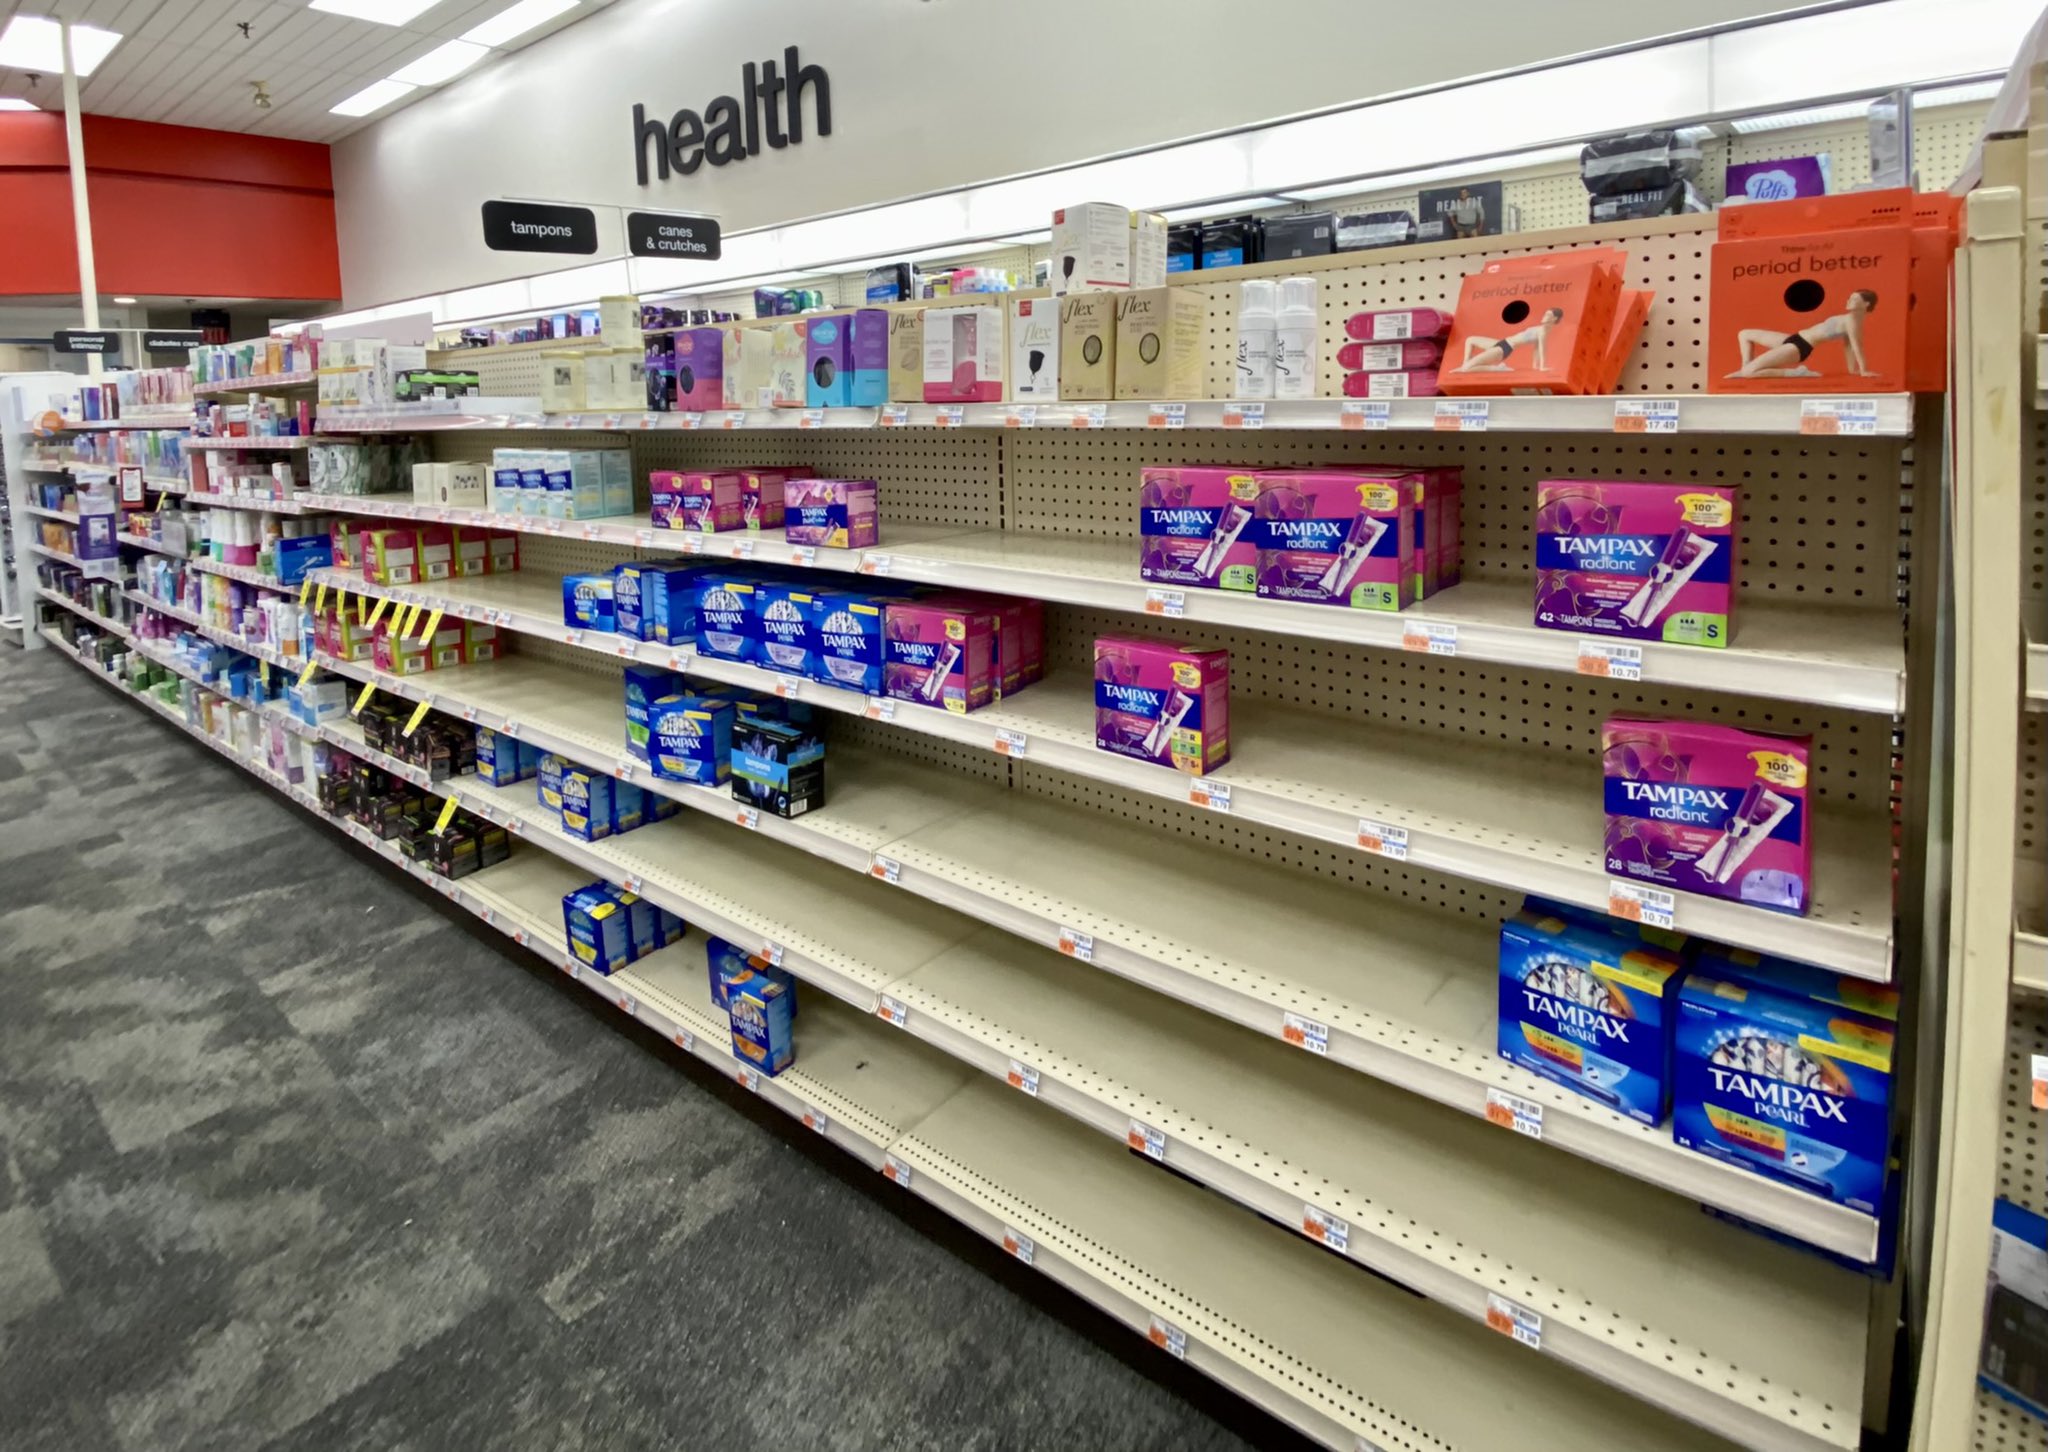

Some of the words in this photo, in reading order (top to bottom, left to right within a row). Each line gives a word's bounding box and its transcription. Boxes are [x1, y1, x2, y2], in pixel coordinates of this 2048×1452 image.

[632, 45, 831, 186] health
[1752, 178, 1789, 200] Puffs
[510, 220, 573, 238] tampons
[658, 225, 693, 238] canes
[646, 237, 656, 250] &
[658, 239, 707, 253] crutches
[1732, 257, 1801, 280] period
[1809, 255, 1882, 272] better
[1472, 284, 1518, 301] period
[1523, 281, 1572, 295] better
[1063, 299, 1095, 324] flex
[1117, 295, 1151, 322] flex
[890, 314, 916, 335] flex
[68, 336, 105, 344] personal
[1019, 322, 1051, 348] flex
[70, 342, 104, 351] intimacy
[1236, 339, 1253, 376] flex
[1274, 339, 1290, 376] flex
[1648, 420, 1676, 430] 17.49
[1150, 510, 1213, 525] TAMPAX
[1166, 525, 1202, 535] radiant
[1267, 521, 1342, 537] TAMPAX
[1286, 538, 1329, 549] radiant
[1554, 536, 1655, 558] TAMPAX
[1580, 556, 1636, 571] radiant
[1246, 573, 1254, 584] S
[1382, 591, 1392, 604] S
[703, 611, 744, 624] TAMPAX
[1539, 612, 1554, 623] 42
[763, 621, 806, 636] TAMPAX
[1706, 624, 1719, 638] S
[821, 633, 867, 650] TAMPAX
[893, 641, 935, 658] TAMPAX
[1612, 668, 1638, 678] 10.79
[1103, 684, 1159, 706] TAMPAX
[658, 736, 701, 750] TAMPAX
[1621, 781, 1729, 810] TAMPAX
[1649, 803, 1710, 824] radiant
[1608, 858, 1623, 870] 28
[1644, 911, 1671, 925] 10.79
[1522, 990, 1630, 1044] TAMPAX
[1707, 1067, 1848, 1124] TAMPAX
[1515, 1120, 1539, 1136] 10.79
